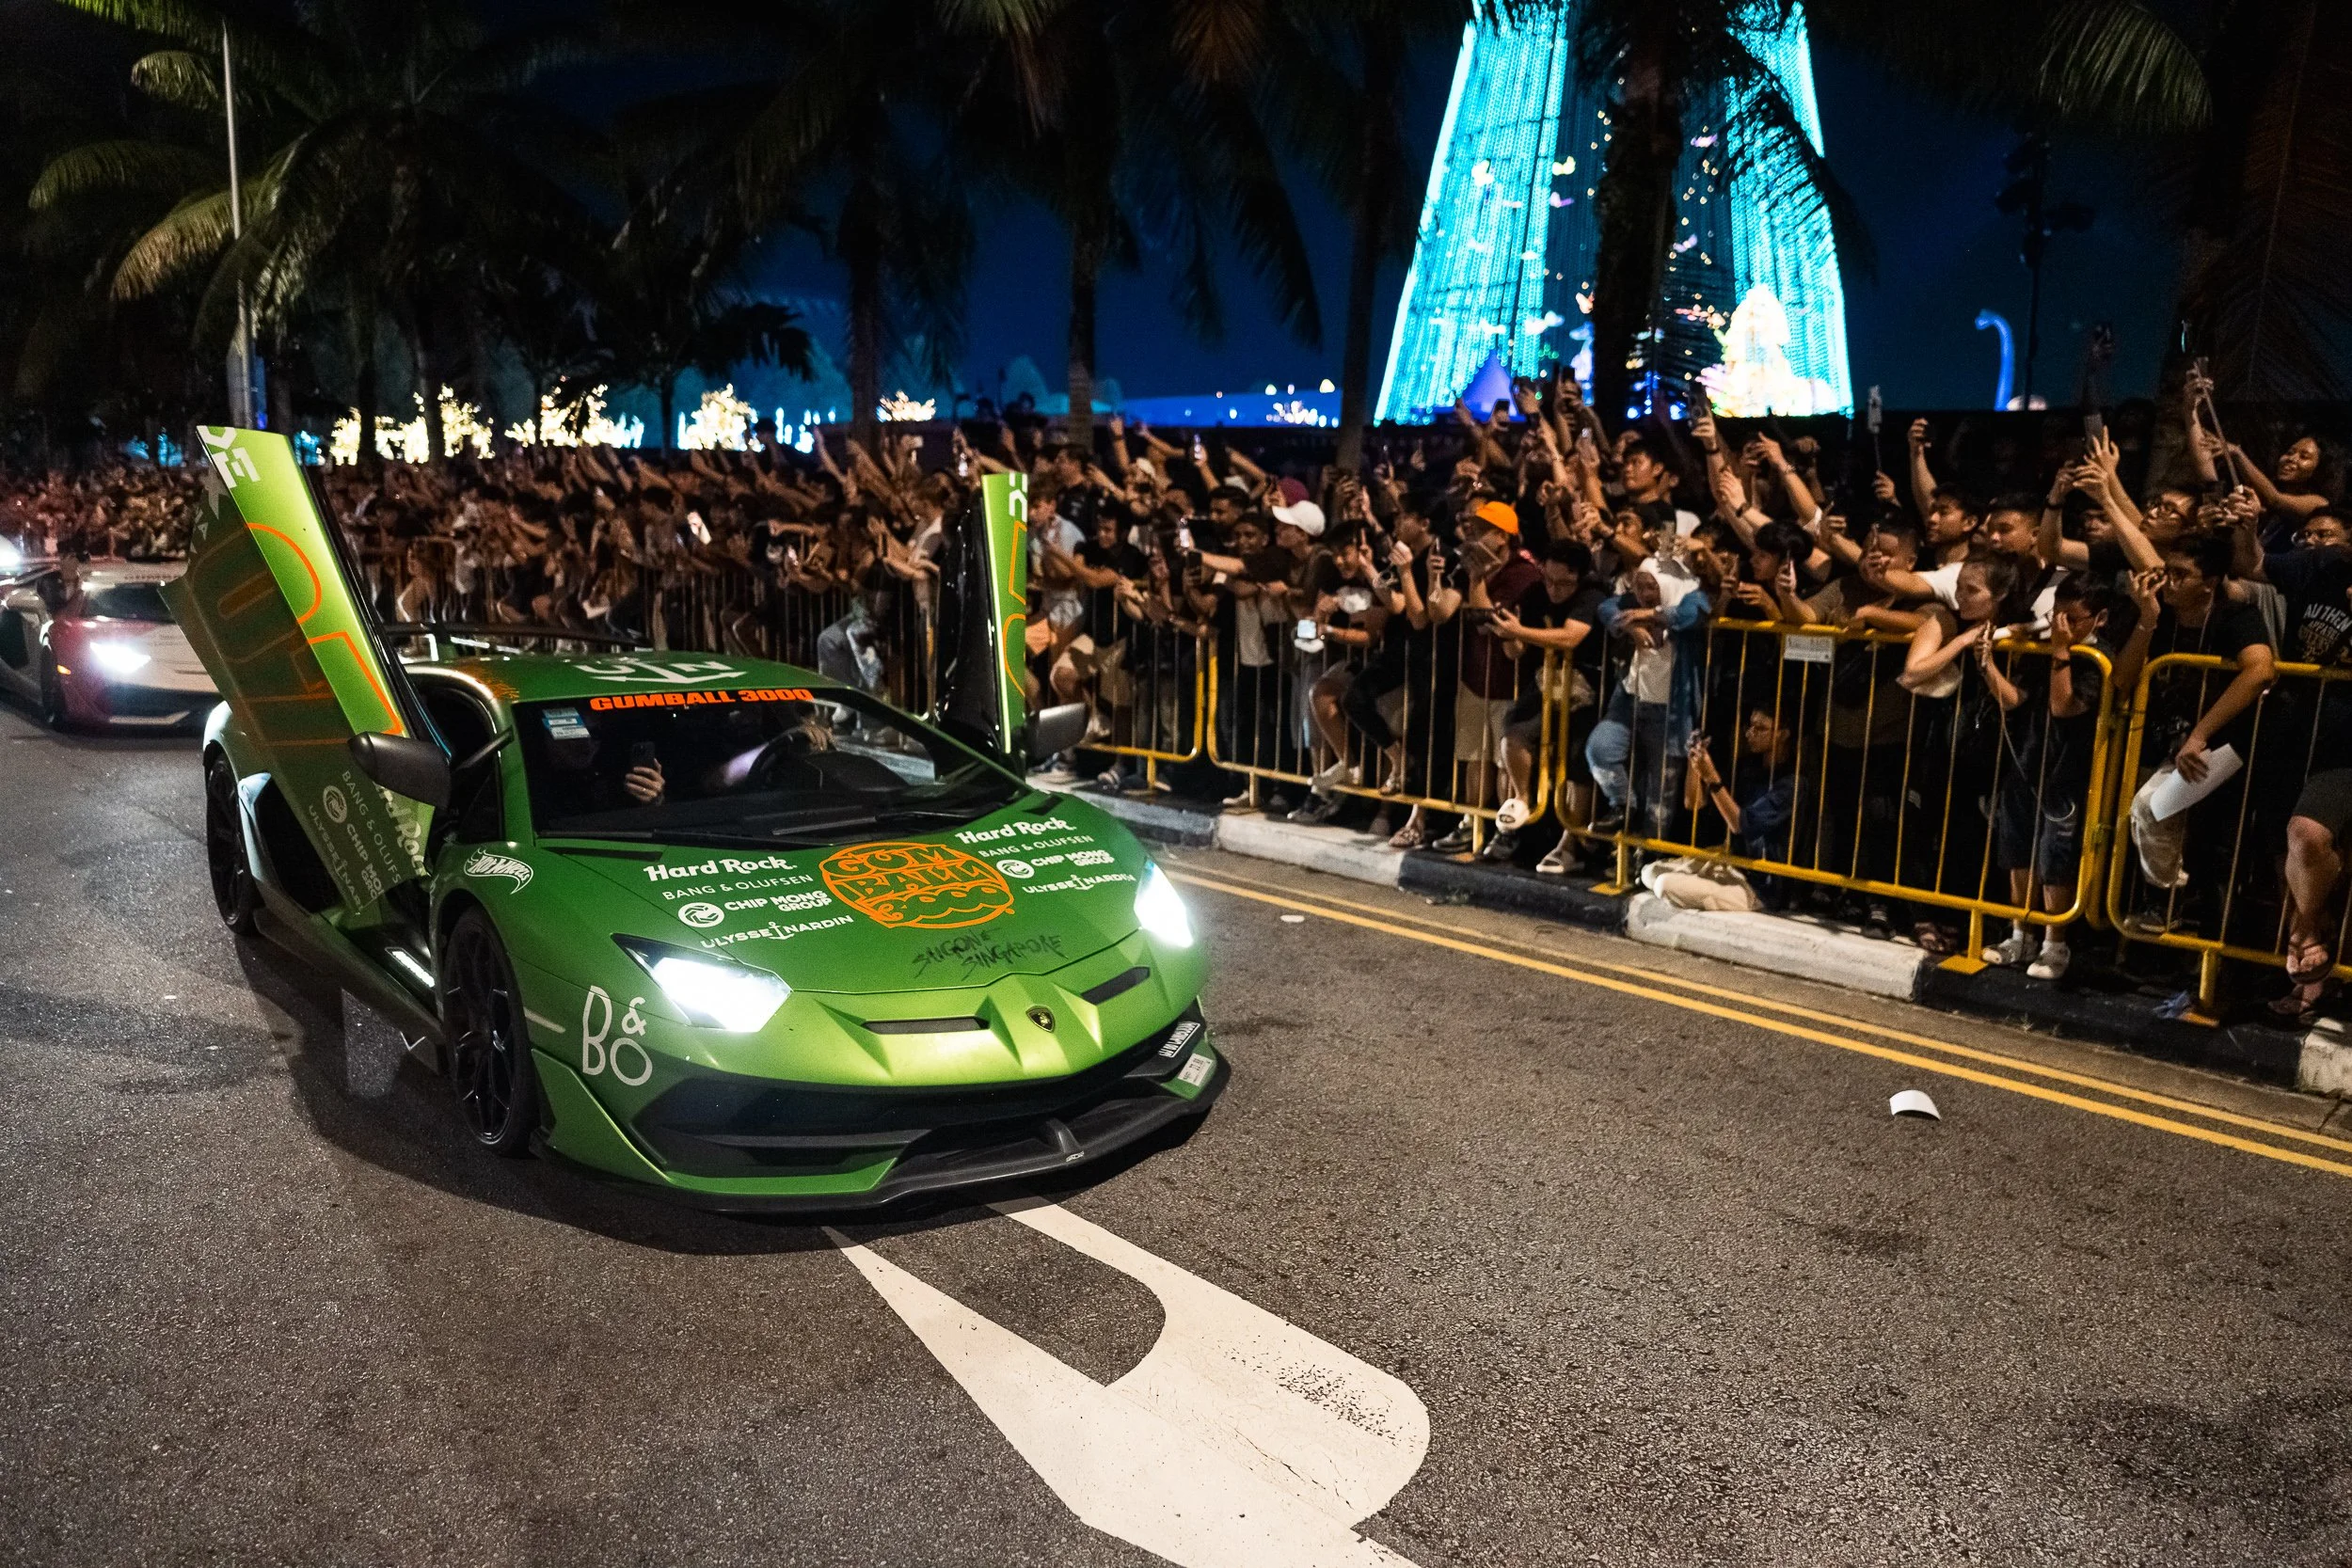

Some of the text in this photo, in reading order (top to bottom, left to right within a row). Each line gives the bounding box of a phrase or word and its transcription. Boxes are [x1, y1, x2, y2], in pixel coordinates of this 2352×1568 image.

[590, 689, 815, 711] GUMBALL 3000
[342, 770, 369, 816] BANG
[955, 817, 1076, 844] Hard Rock
[347, 824, 369, 862] CHIP
[978, 846, 1020, 858] BANG
[1034, 835, 1094, 849] OLUFSEN
[644, 856, 797, 881] Hard Rock
[1031, 849, 1111, 866] CHIP MONG
[1073, 856, 1115, 866] GROUP
[662, 886, 715, 900] BANG
[736, 874, 814, 890] OLUFSEN
[1024, 874, 1136, 894] ULYSSE NARDIN
[724, 891, 827, 911] CHIP MONG
[778, 897, 832, 911] GROUP
[701, 915, 853, 948] ULYSSE NARDIN
